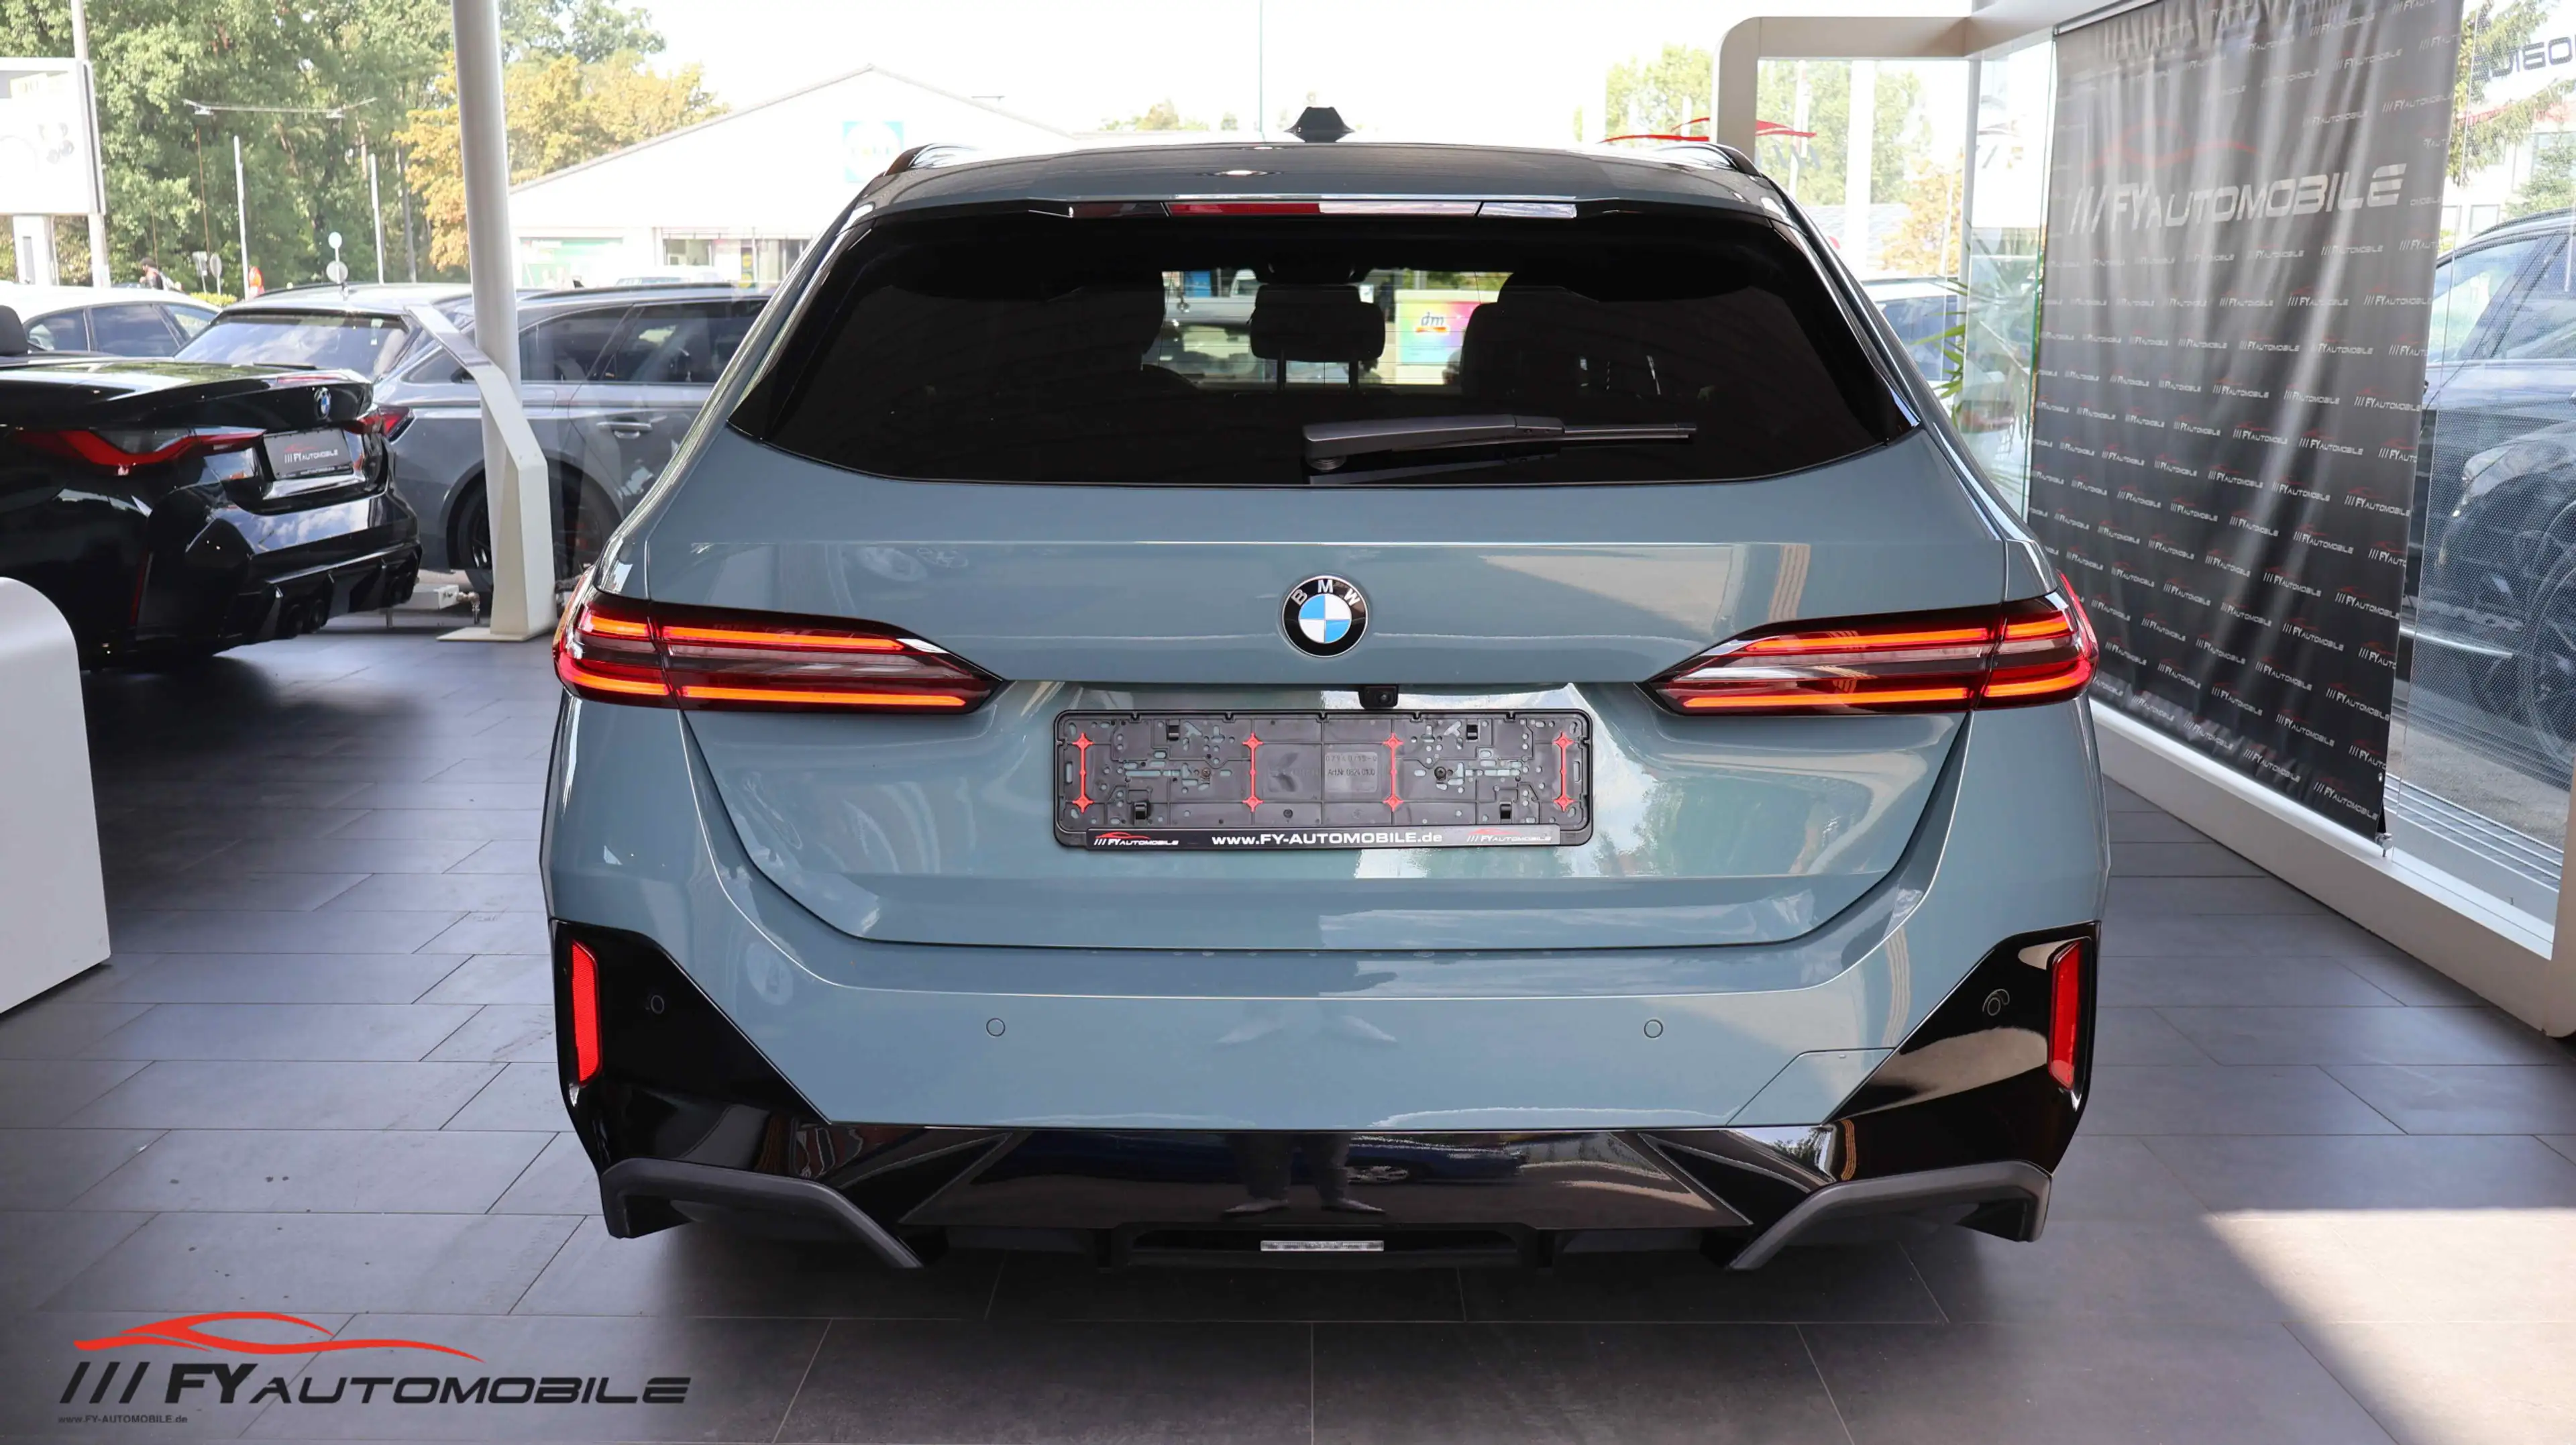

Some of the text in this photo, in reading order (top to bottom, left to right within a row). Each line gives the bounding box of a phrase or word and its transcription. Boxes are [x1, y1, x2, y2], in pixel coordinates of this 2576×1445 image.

[1421, 312, 1444, 325] dm
[1291, 579, 1360, 606] BMW
[1212, 833, 1442, 845] www.FY-AUTOMOBILE.de
